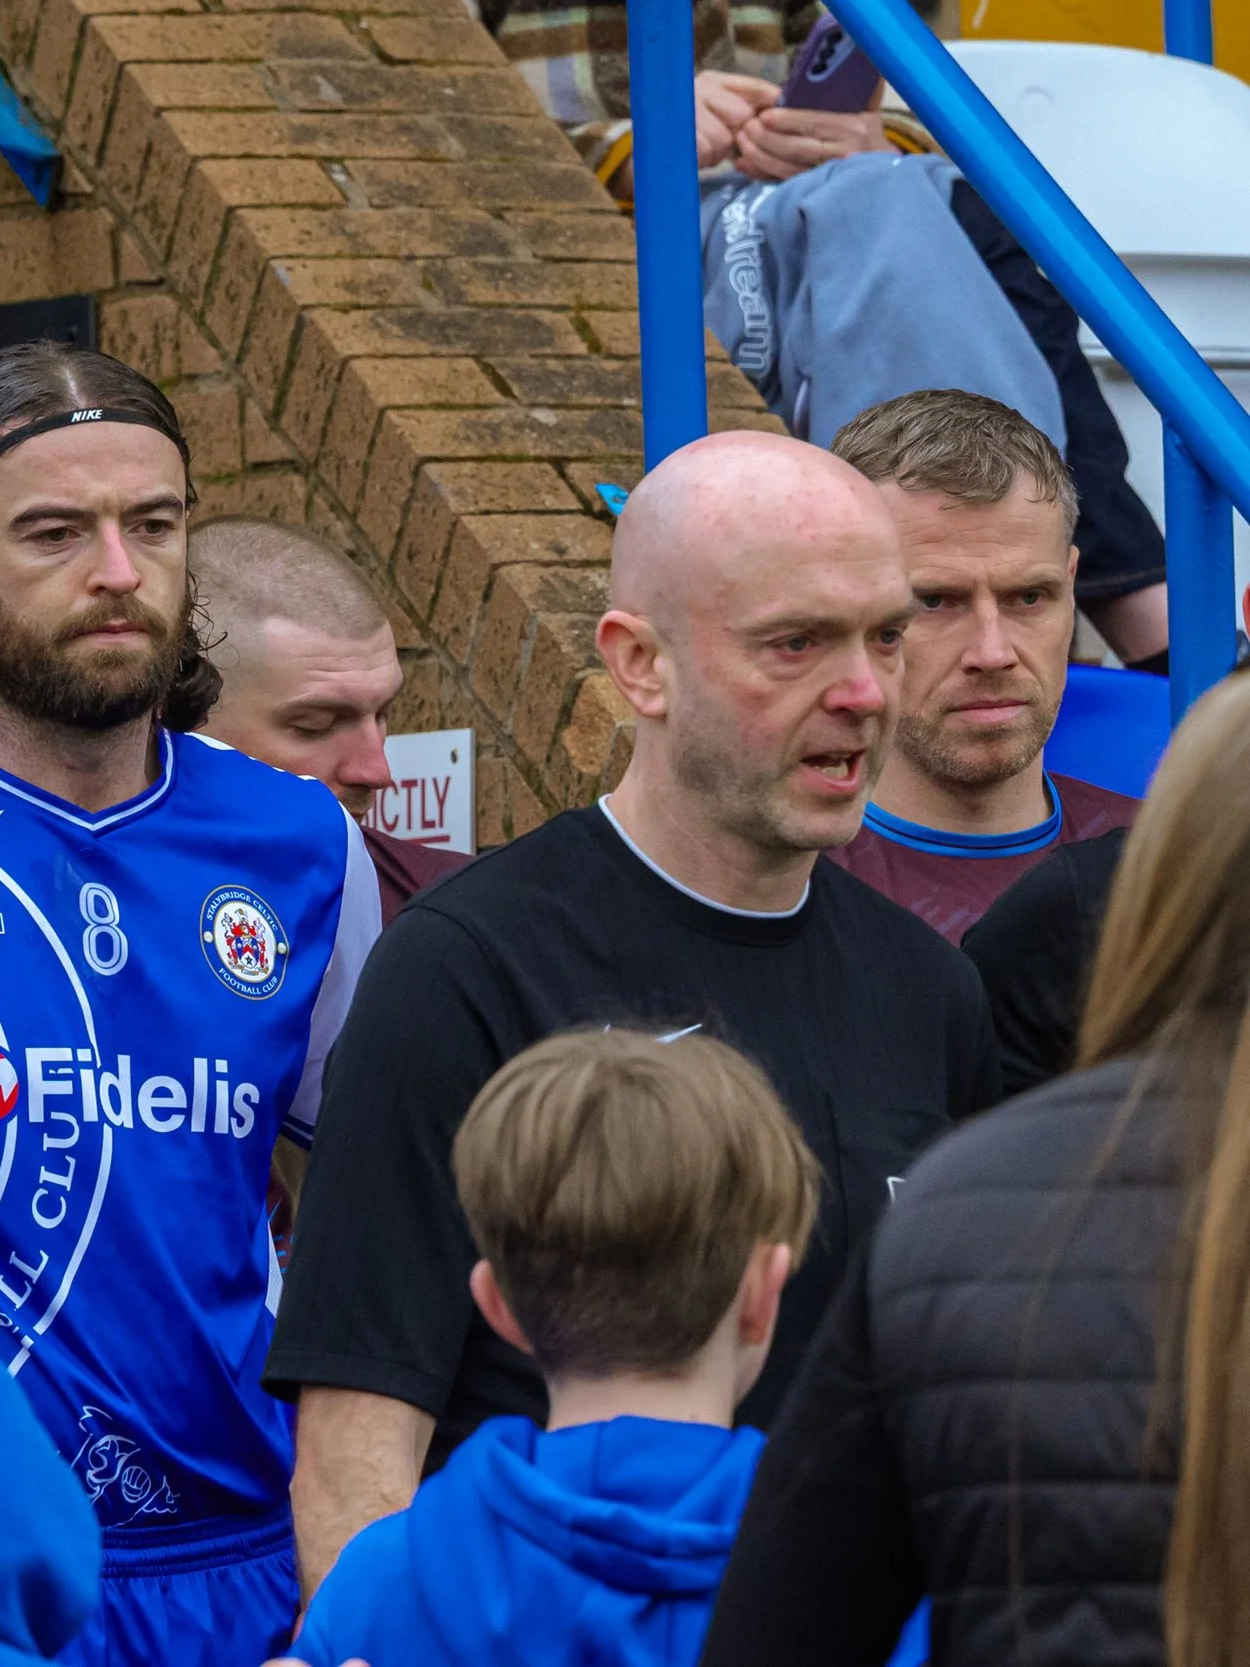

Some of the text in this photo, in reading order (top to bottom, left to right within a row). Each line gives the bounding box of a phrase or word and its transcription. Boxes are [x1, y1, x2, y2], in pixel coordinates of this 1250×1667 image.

[71, 409, 103, 422] NIKE
[363, 775, 451, 833] ICTLY
[79, 882, 129, 976] 8
[206, 890, 278, 932] STALYBRIDGE CELTIC
[218, 967, 262, 995] FOOTBALL
[262, 975, 278, 993] CLUB
[24, 1046, 260, 1139] Fidelis
[31, 1110, 81, 1230] CLU
